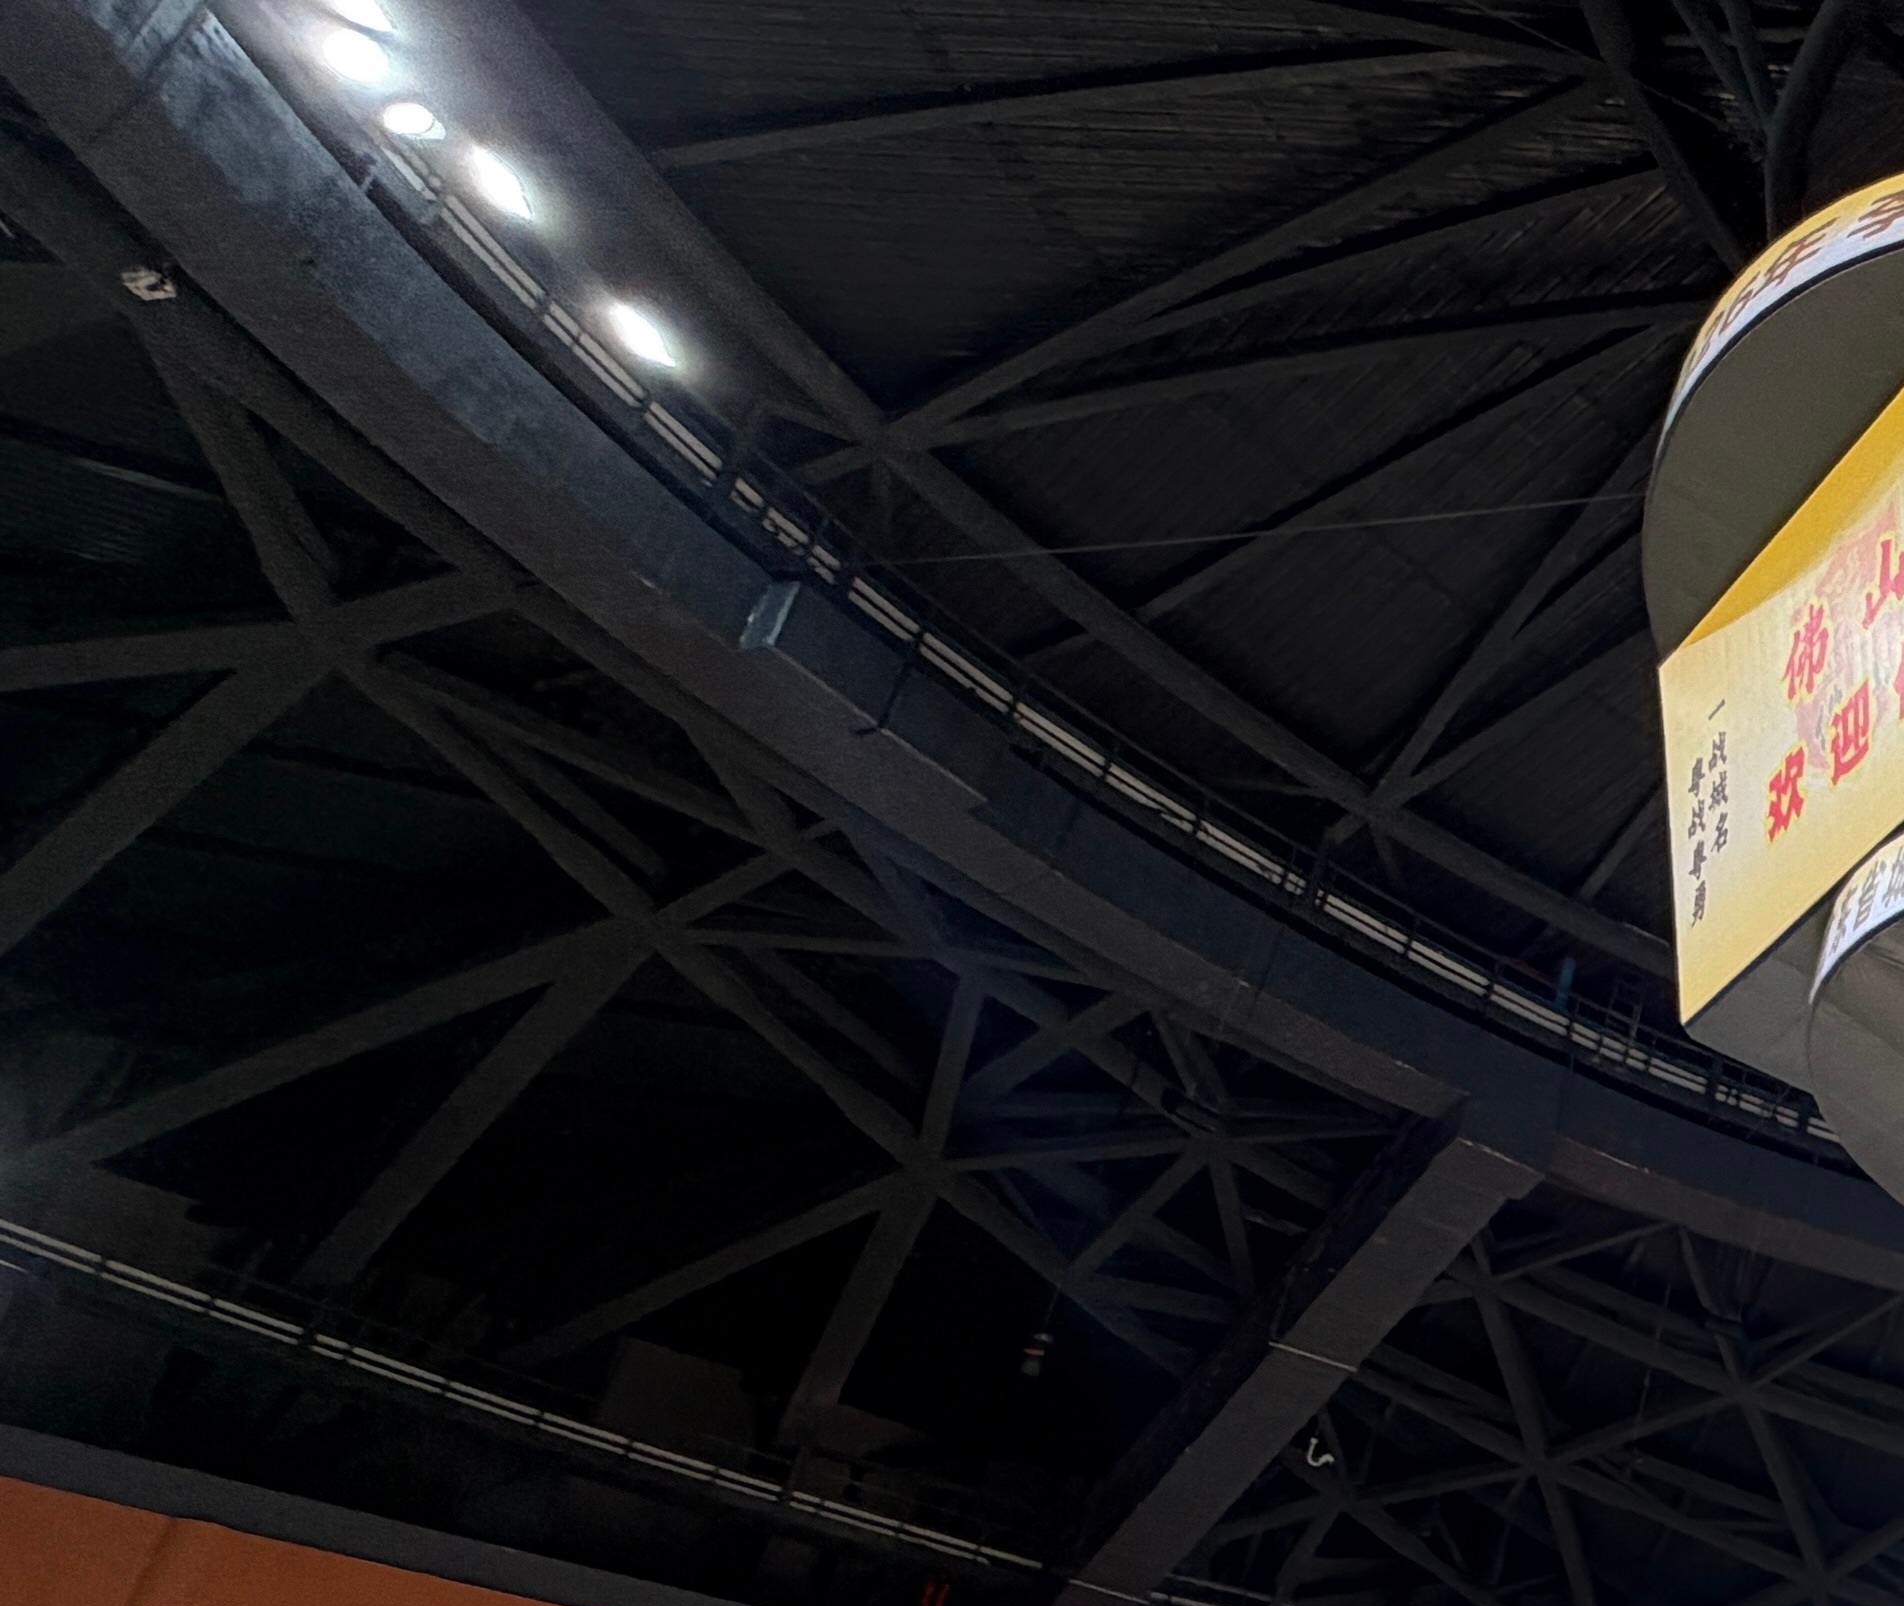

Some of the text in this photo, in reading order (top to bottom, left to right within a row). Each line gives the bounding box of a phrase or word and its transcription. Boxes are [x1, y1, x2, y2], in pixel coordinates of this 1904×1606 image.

[1688, 757, 1708, 928] 粤战粤勇
[1707, 699, 1729, 853] 一战城名
